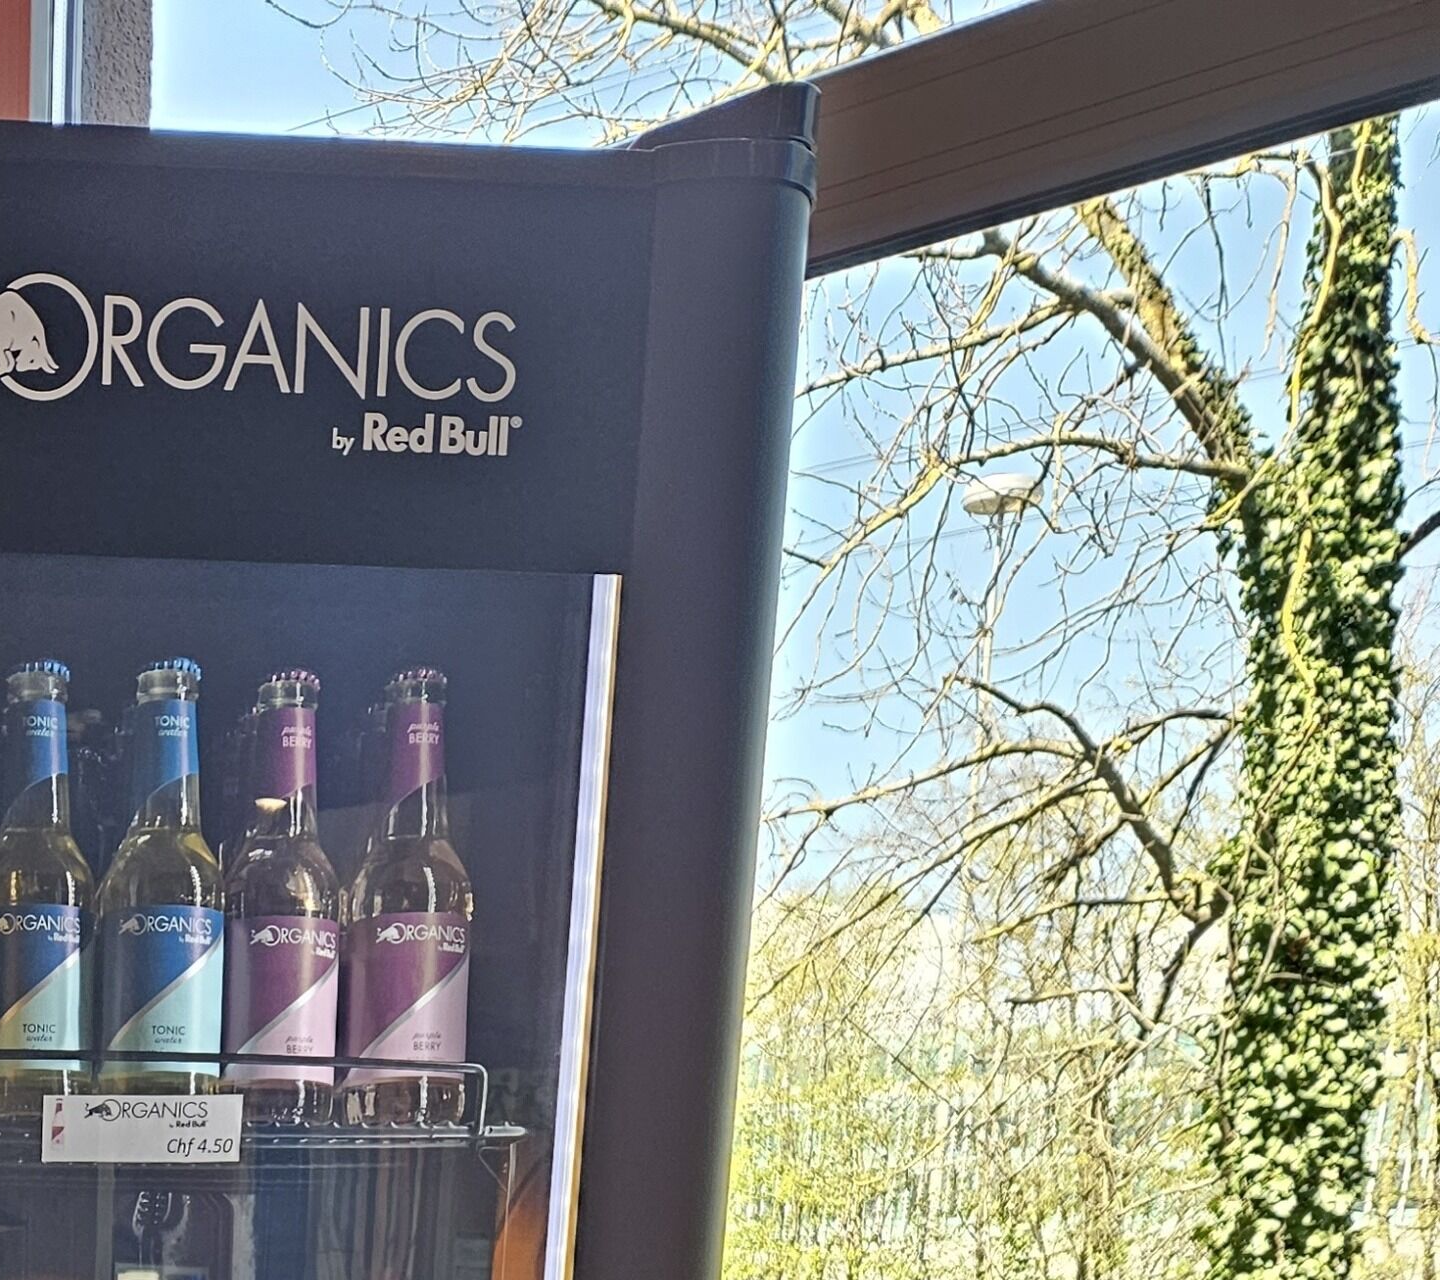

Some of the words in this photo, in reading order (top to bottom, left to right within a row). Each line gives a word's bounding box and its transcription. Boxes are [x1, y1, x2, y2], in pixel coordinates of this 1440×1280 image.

[1, 272, 517, 402] ORGANICS
[331, 427, 356, 456] by
[362, 411, 436, 455] Red
[22, 714, 59, 730] TONIC
[154, 714, 191, 730] TONIC
[282, 735, 312, 749] BERRY
[408, 732, 440, 745] BERRY
[1, 912, 80, 935] ORGANICS
[133, 912, 212, 935] ORGANICS
[263, 925, 337, 949] ORGANICS
[389, 922, 465, 945] ORGANICS
[23, 1023, 56, 1034] TONIC
[152, 1025, 186, 1036] TONIC
[286, 1044, 313, 1055] BERRY
[413, 1040, 442, 1051] BERRY
[101, 1098, 208, 1122] ORGANICS
[175, 1120, 190, 1128] Red
[166, 1137, 194, 1158] Chf
[197, 1137, 234, 1154] 4.50
